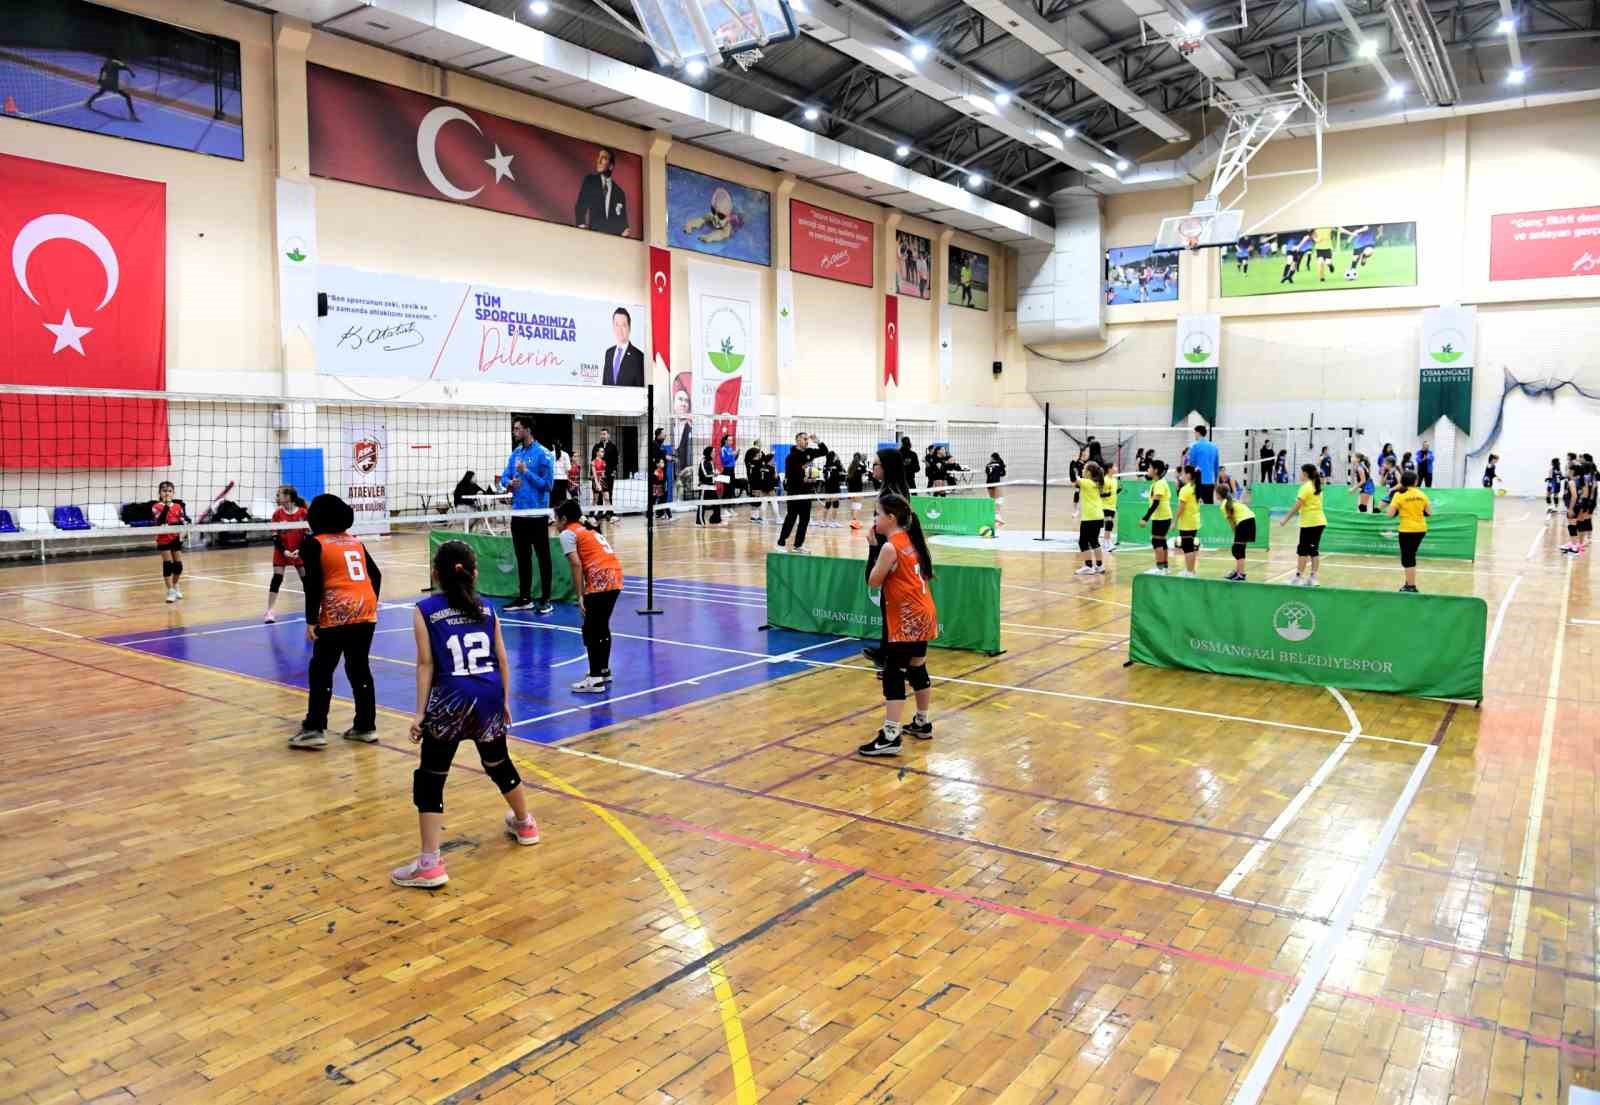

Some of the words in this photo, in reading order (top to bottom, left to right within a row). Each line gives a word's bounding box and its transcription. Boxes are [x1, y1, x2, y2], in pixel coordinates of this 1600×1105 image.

[475, 292, 501, 308] TÜM
[475, 308, 577, 330] SPORCULARIMIZA
[508, 324, 577, 343] BAŞARILAR
[479, 324, 564, 373] Dilerim
[348, 486, 386, 499] ATAEVLER
[343, 550, 366, 581] 6
[446, 631, 494, 677] 12
[1189, 638, 1275, 661] OSMANGAZİ
